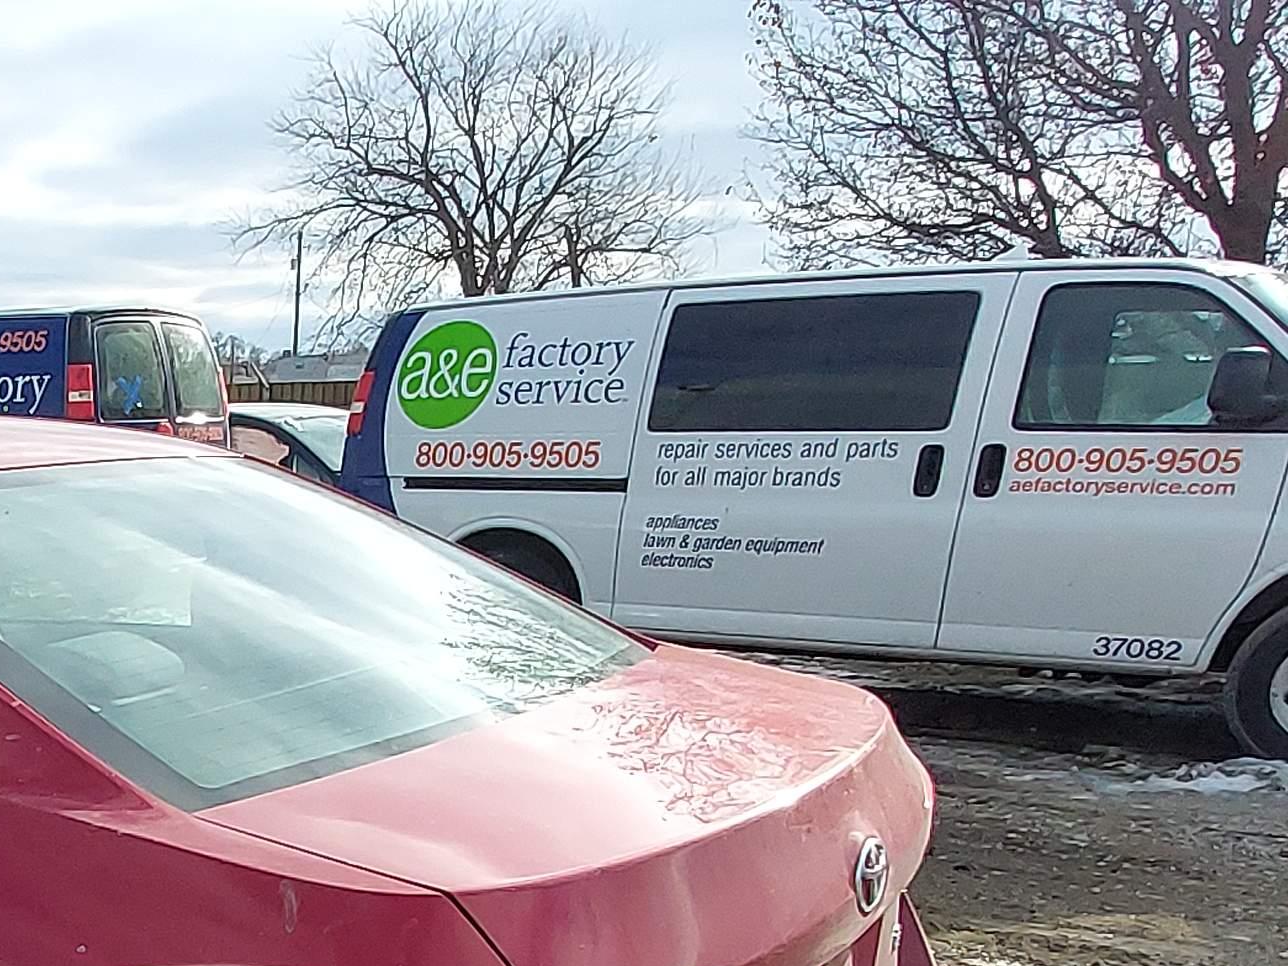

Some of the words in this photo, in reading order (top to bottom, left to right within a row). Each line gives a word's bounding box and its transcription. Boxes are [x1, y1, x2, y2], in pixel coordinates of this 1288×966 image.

[503, 332, 636, 376] factory
[401, 347, 493, 401] a&e
[495, 369, 625, 406] service
[658, 439, 707, 463] repair
[714, 440, 793, 460] services
[800, 438, 839, 459] and
[846, 438, 899, 462] parts
[655, 467, 679, 487] for
[684, 467, 706, 487] all
[713, 468, 768, 490] major
[772, 467, 842, 487] brands
[1009, 477, 1236, 497] aefactoryservice.com
[645, 514, 720, 532] appliances
[643, 534, 676, 549] lawn
[679, 534, 690, 549] &
[692, 536, 742, 553] garden
[745, 538, 825, 556] equipment
[641, 552, 714, 570] electronics
[1092, 636, 1183, 662] 37082
